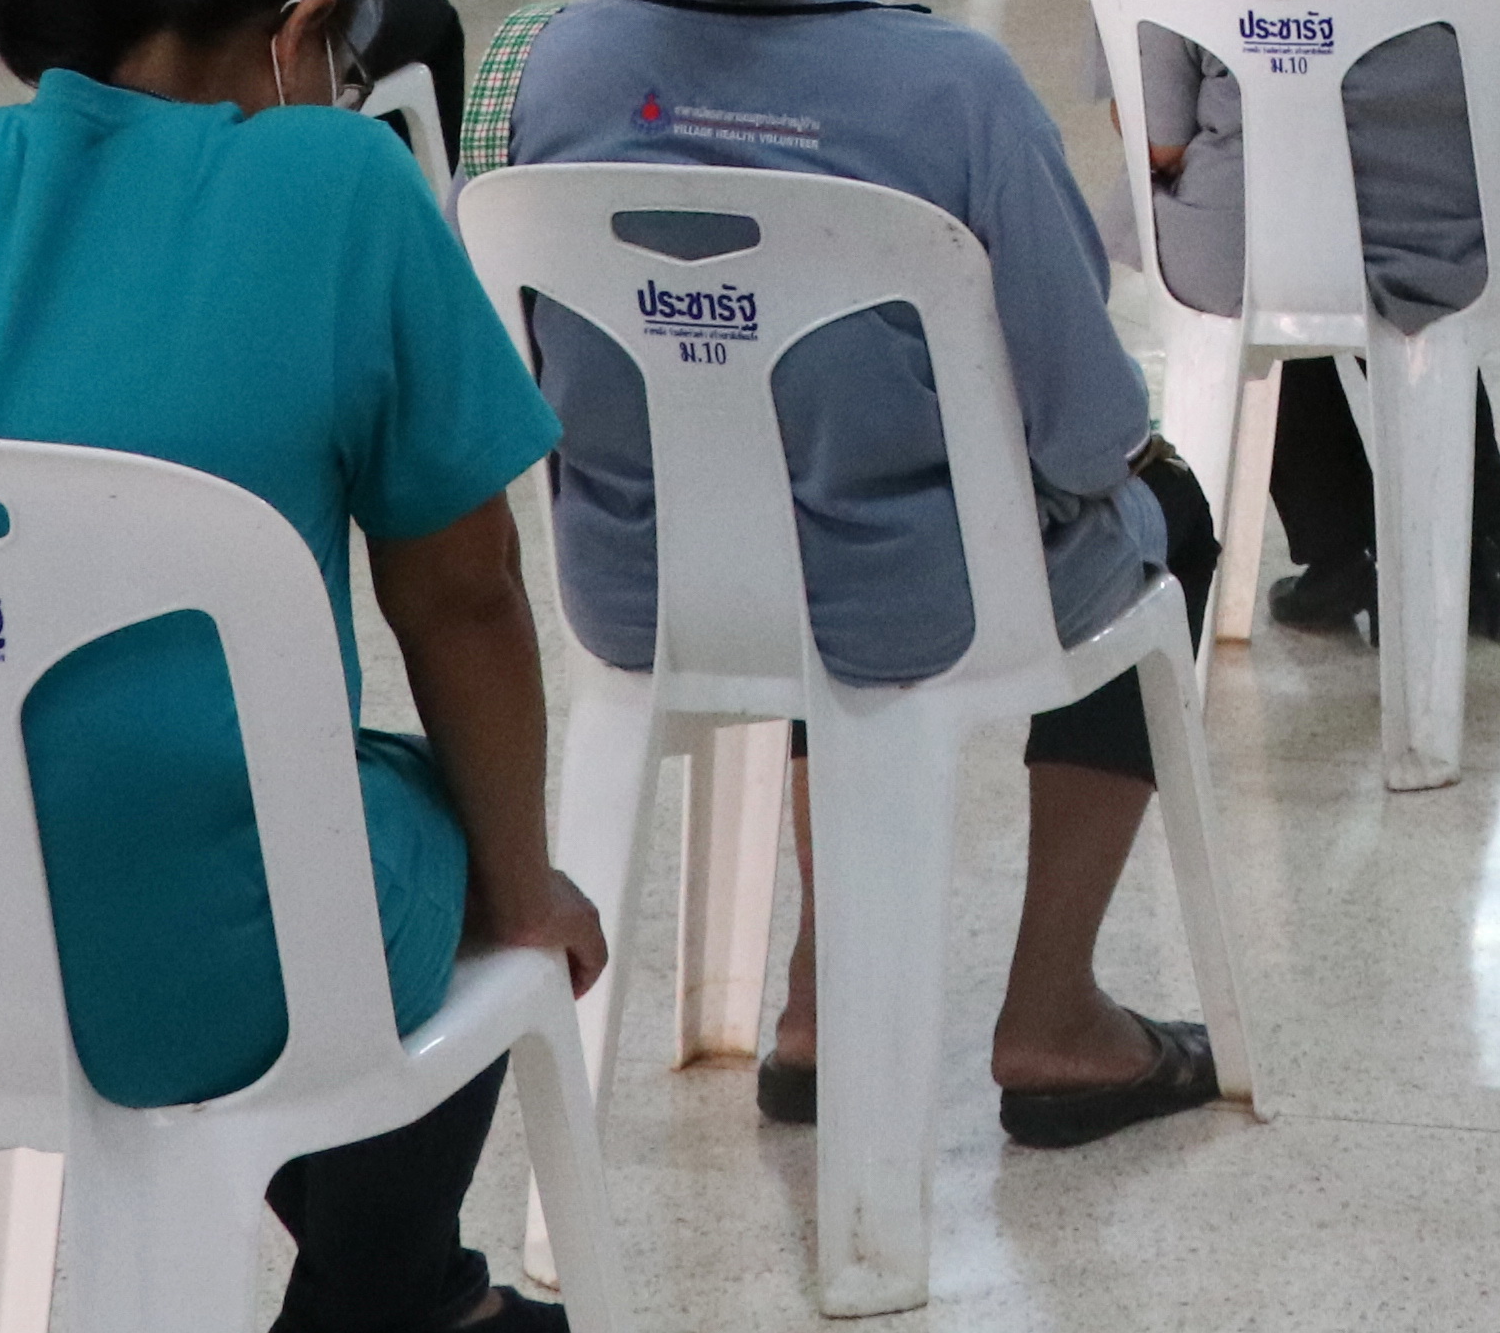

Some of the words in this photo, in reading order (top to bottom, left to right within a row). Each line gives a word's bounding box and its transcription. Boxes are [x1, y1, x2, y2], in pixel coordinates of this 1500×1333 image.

[1239, 10, 1334, 47] ประชารัฐ
[1270, 56, 1308, 74] ม.10
[637, 279, 758, 331] ประชารัฐ
[679, 341, 726, 365] ม.10
